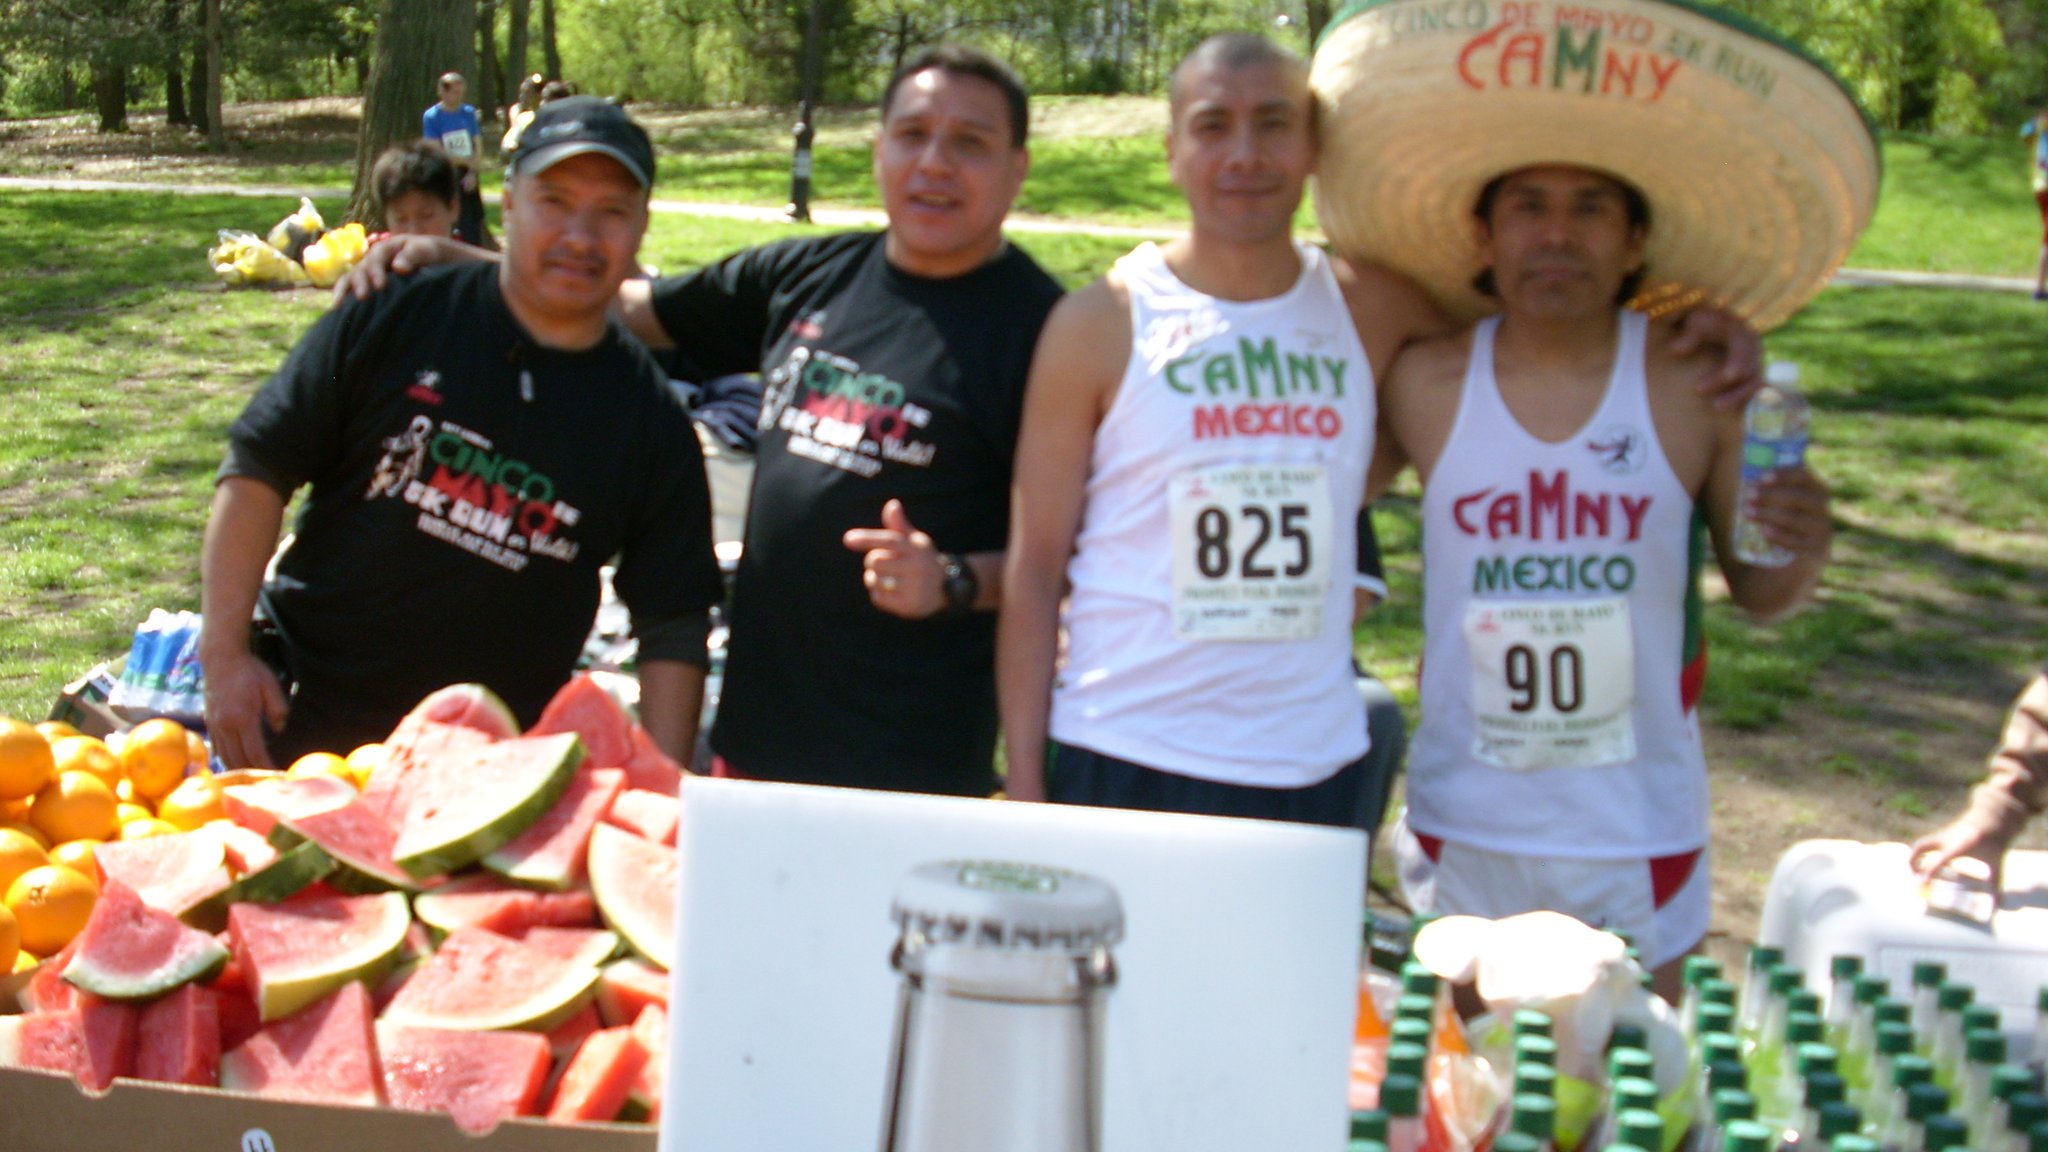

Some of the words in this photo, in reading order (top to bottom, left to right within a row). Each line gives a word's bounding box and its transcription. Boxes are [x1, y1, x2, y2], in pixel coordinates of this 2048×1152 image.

[1390, 0, 1488, 36] CINCO
[1502, 1, 1540, 28] DE
[1554, 5, 1654, 46] MAYO
[1714, 44, 1778, 97] RUN
[1458, 20, 1682, 102] CAMNY
[803, 359, 905, 408] CINCO
[1165, 335, 1346, 398] CAMNY
[801, 390, 908, 442] MAYO
[1193, 403, 1342, 440] MEXICO
[428, 465, 557, 537] MAYO
[430, 432, 555, 502] CINCO
[449, 499, 513, 543] RUN
[1452, 469, 1654, 541] CAMNY
[1195, 505, 1311, 579] 825
[1473, 553, 1637, 592] MEXICO
[1505, 642, 1584, 713] 90
